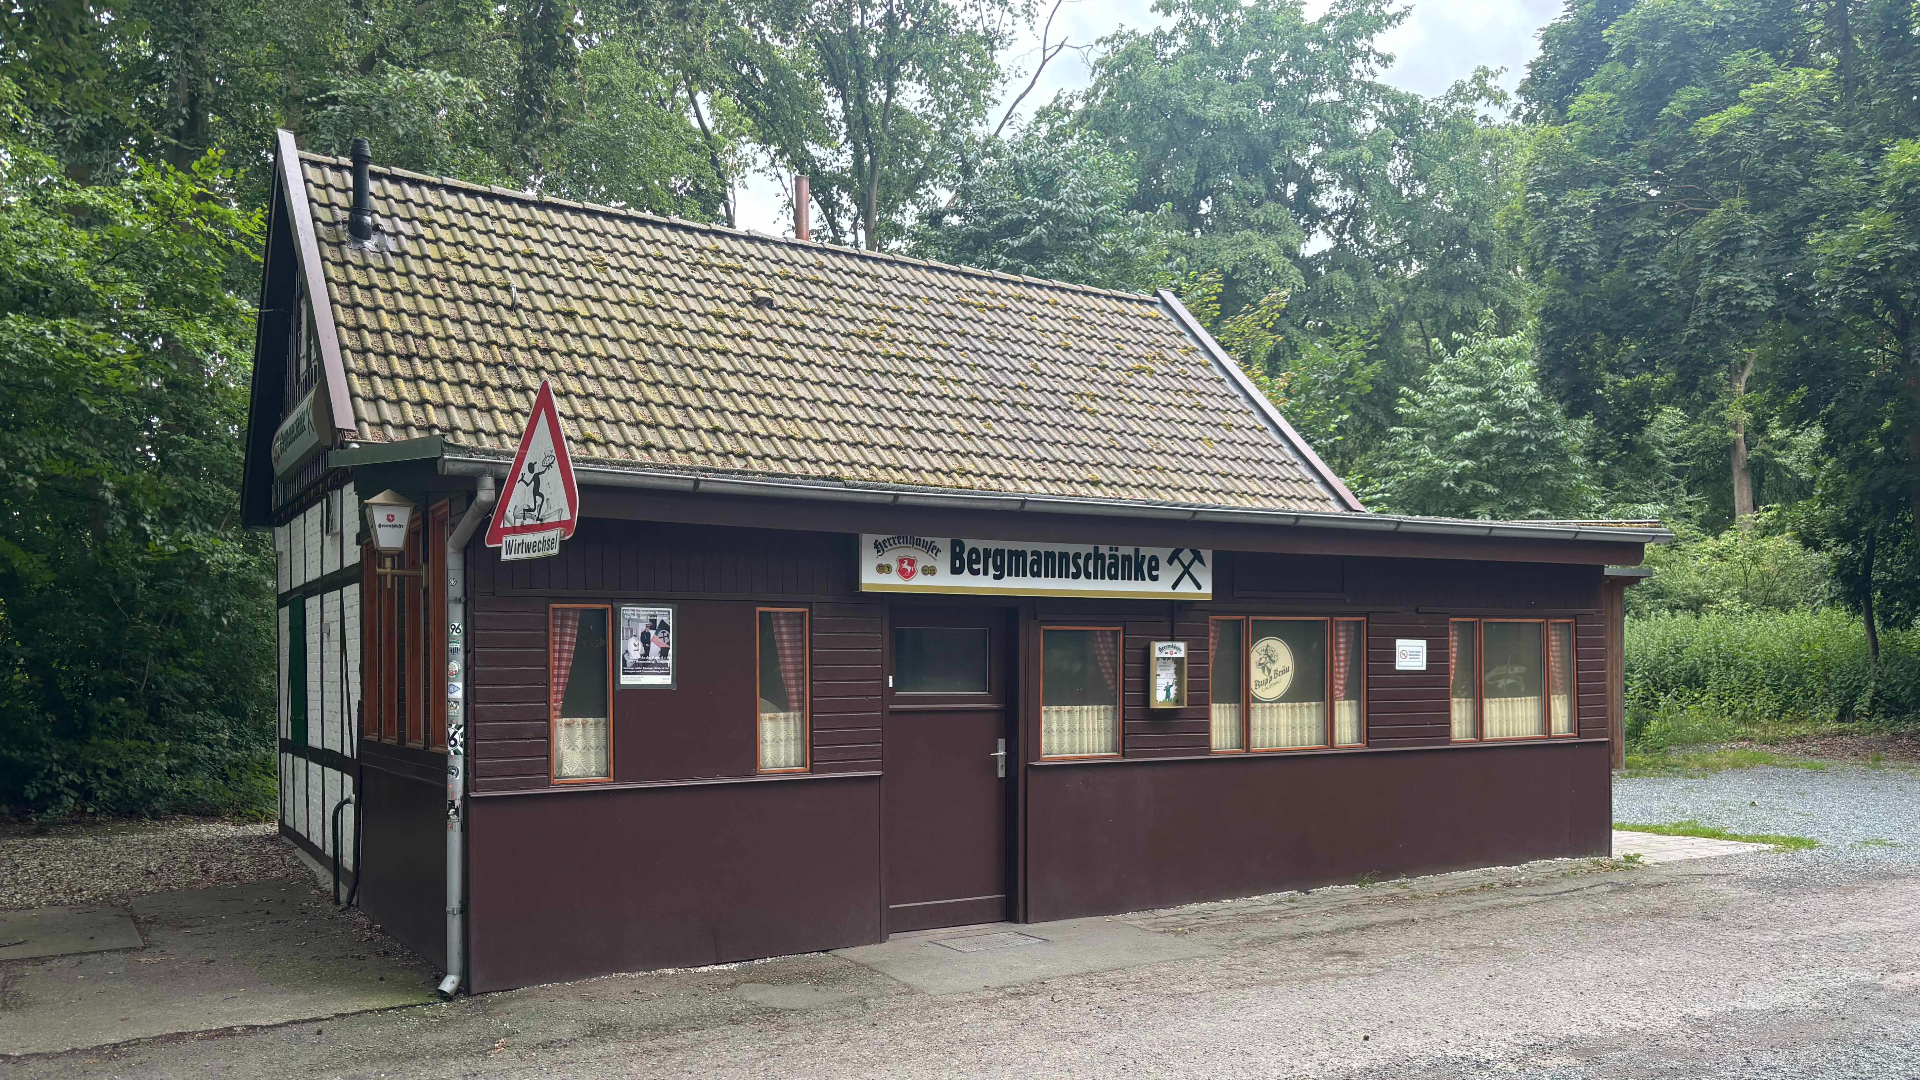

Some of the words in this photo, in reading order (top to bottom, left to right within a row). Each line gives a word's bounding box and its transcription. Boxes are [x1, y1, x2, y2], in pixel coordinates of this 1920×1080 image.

[505, 534, 558, 555] Wirtwechsel
[951, 538, 1160, 582] Bergmannschänke
[450, 623, 462, 635] 96
[1254, 675, 1273, 690] Rupp
[1273, 665, 1290, 679] Bräu
[447, 730, 458, 748] 6
